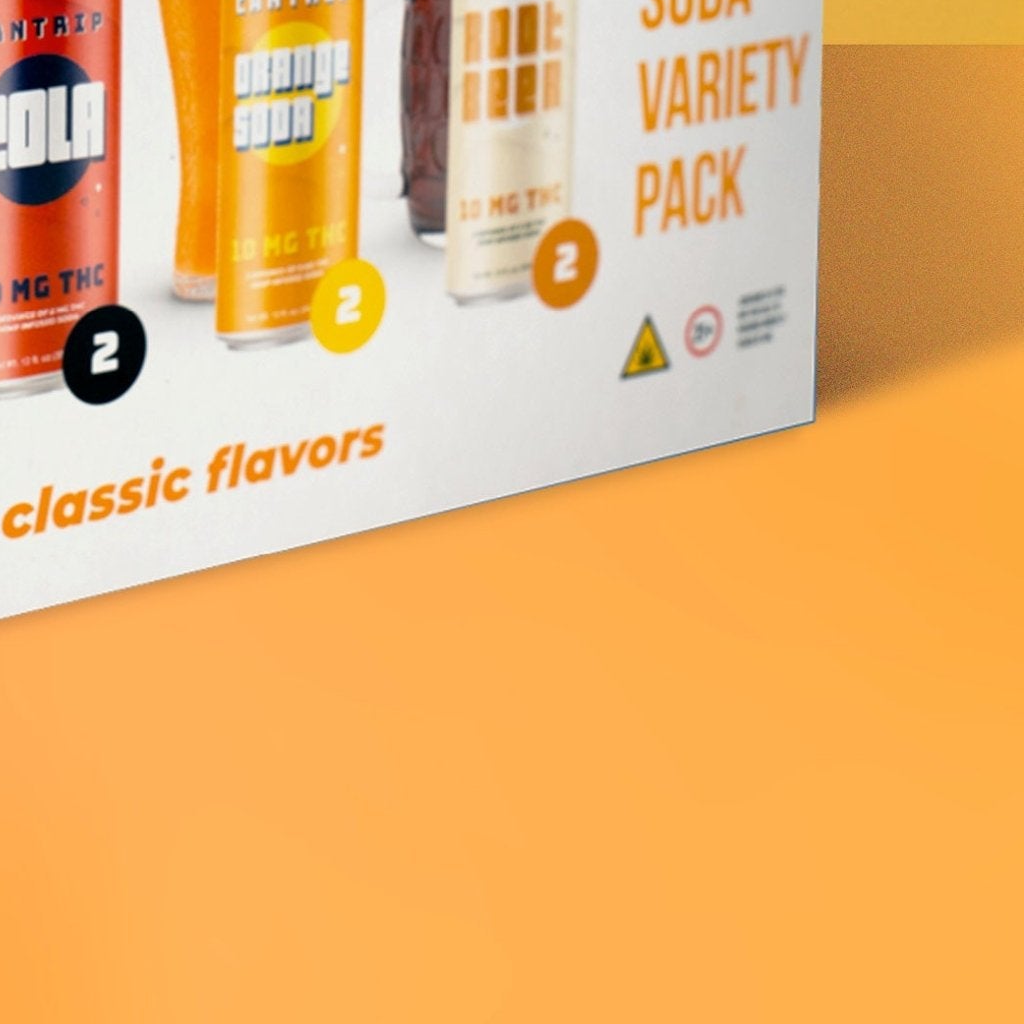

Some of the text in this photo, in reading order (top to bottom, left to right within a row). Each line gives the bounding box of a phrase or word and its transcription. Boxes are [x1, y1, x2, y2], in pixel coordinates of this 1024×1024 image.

[636, 32, 811, 134] VARIETY
[634, 142, 747, 238] PACK
[263, 230, 299, 259] MG
[553, 241, 579, 283] 2
[11, 273, 51, 304] MG
[58, 262, 105, 296] THC
[335, 284, 362, 325] 2
[90, 330, 120, 376] 2
[0, 456, 191, 540] classic
[206, 422, 386, 494] flavors
